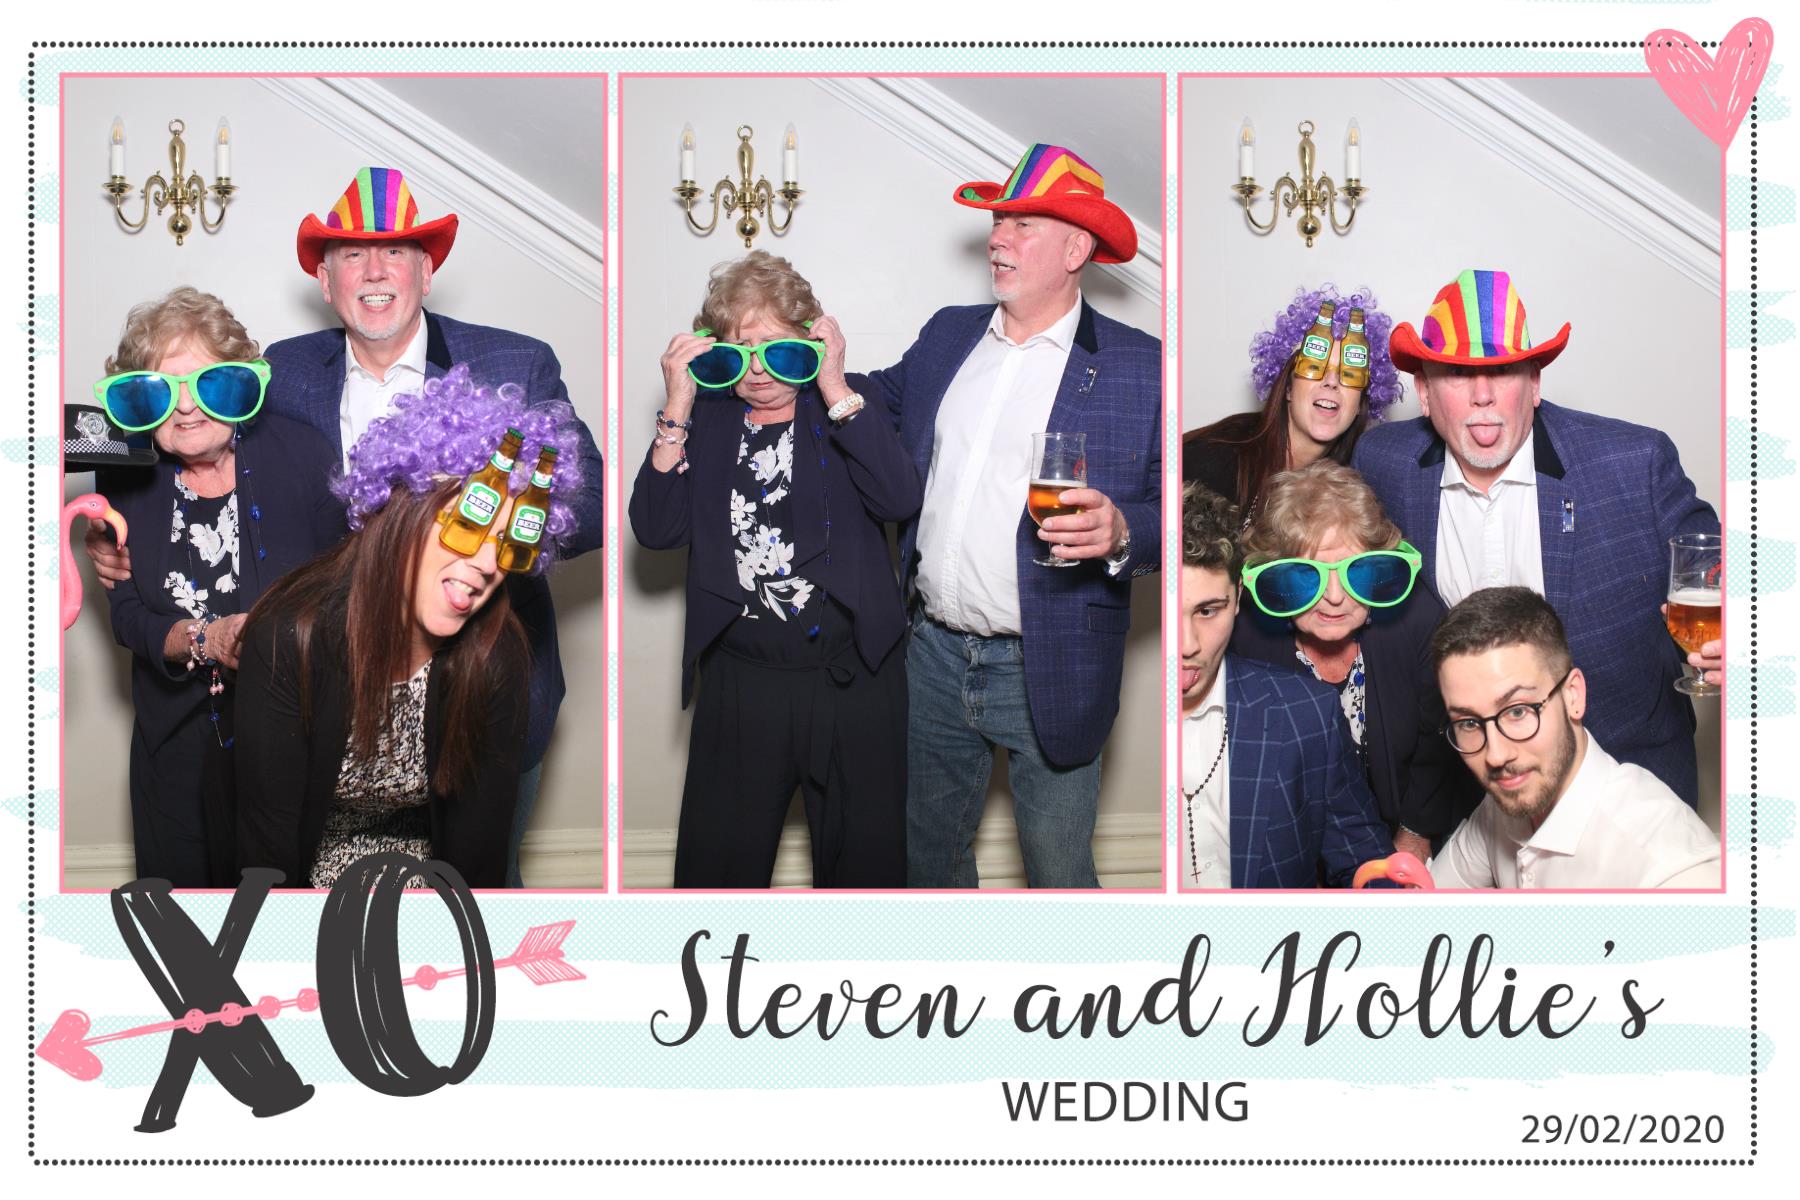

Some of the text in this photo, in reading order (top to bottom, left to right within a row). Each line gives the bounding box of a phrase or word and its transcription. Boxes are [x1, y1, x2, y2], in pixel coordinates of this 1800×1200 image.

[1306, 343, 1325, 353] BEER
[1346, 352, 1365, 360] BEER
[468, 494, 494, 513] BEER
[517, 519, 540, 531] BEER
